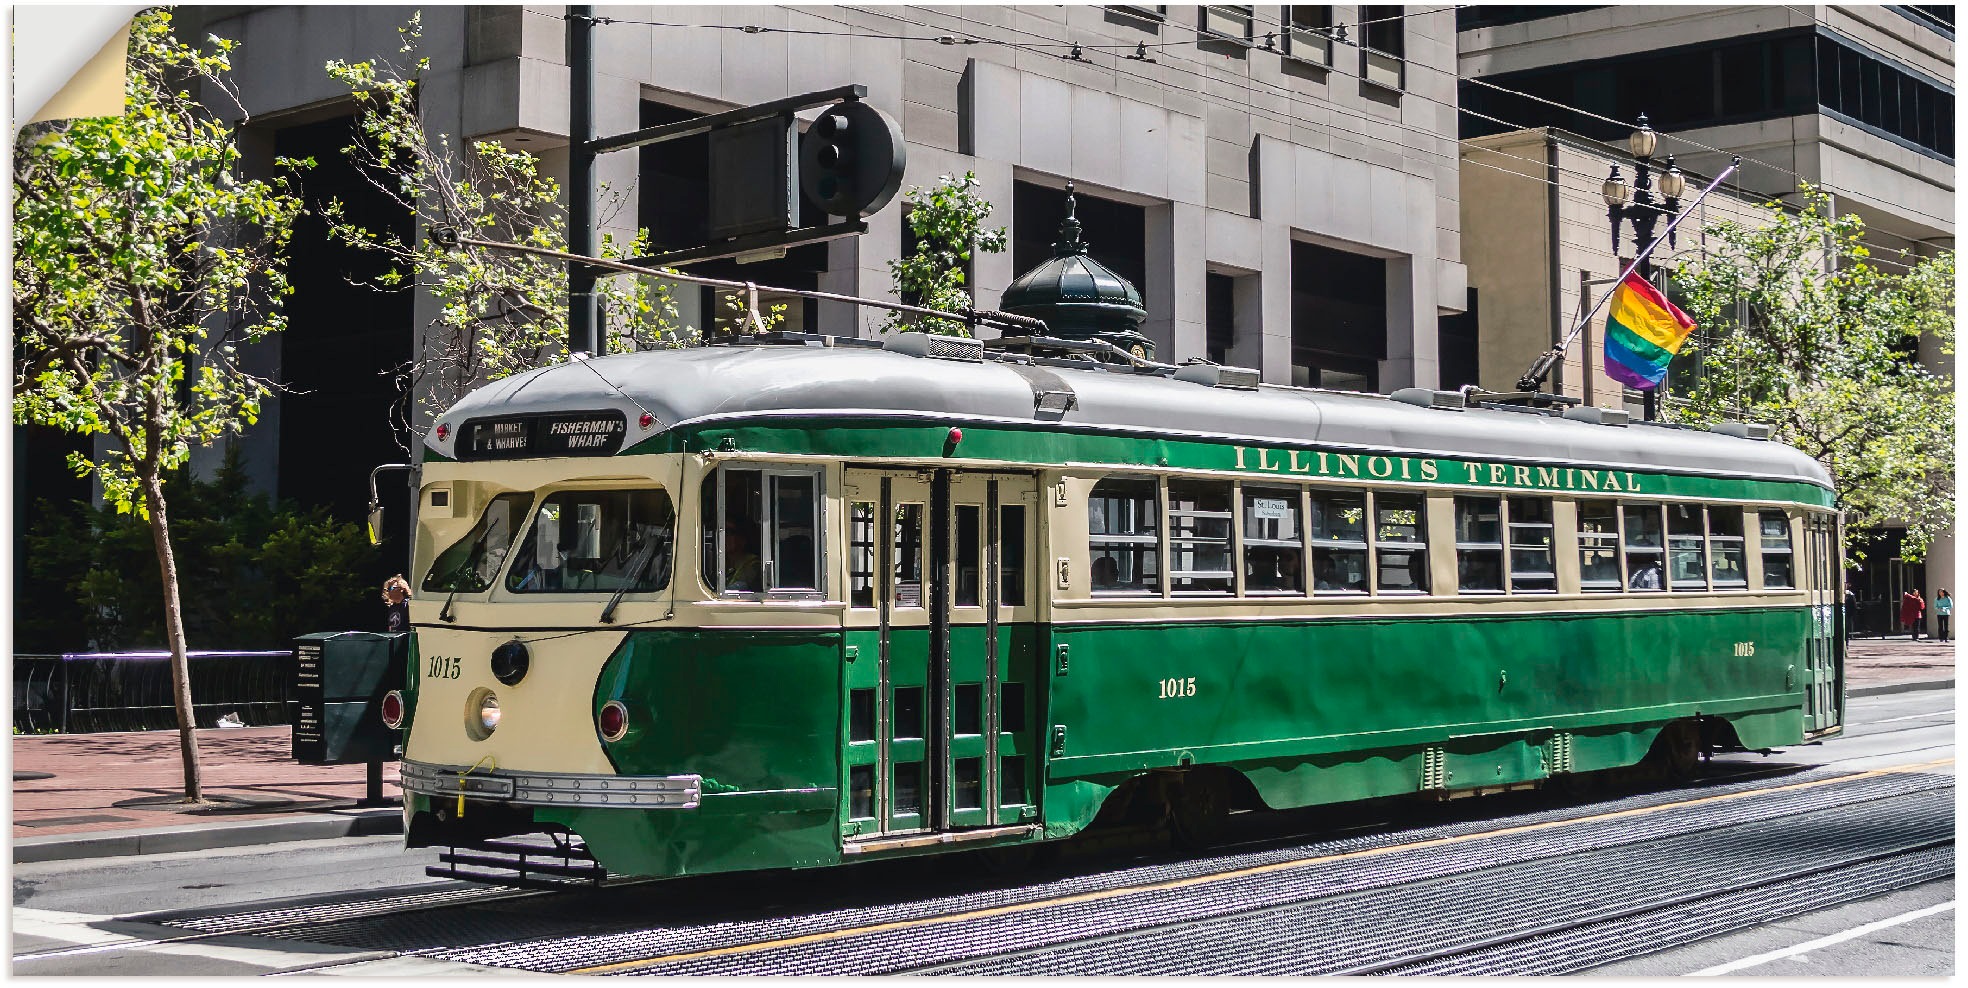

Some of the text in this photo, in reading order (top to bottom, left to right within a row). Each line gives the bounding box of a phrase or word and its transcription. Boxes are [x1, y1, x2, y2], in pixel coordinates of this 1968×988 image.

[494, 422, 523, 434] MARKET
[550, 420, 624, 435] FISHERMAN'S
[473, 425, 482, 451] F
[487, 439, 493, 450] &
[568, 434, 609, 448] WHARF
[1233, 445, 1641, 492] ILLINOIS TERMINAL
[1267, 500, 1285, 510] Louis
[1733, 641, 1755, 657] 1015
[427, 655, 462, 680] 1015
[1158, 676, 1197, 699] 1015
